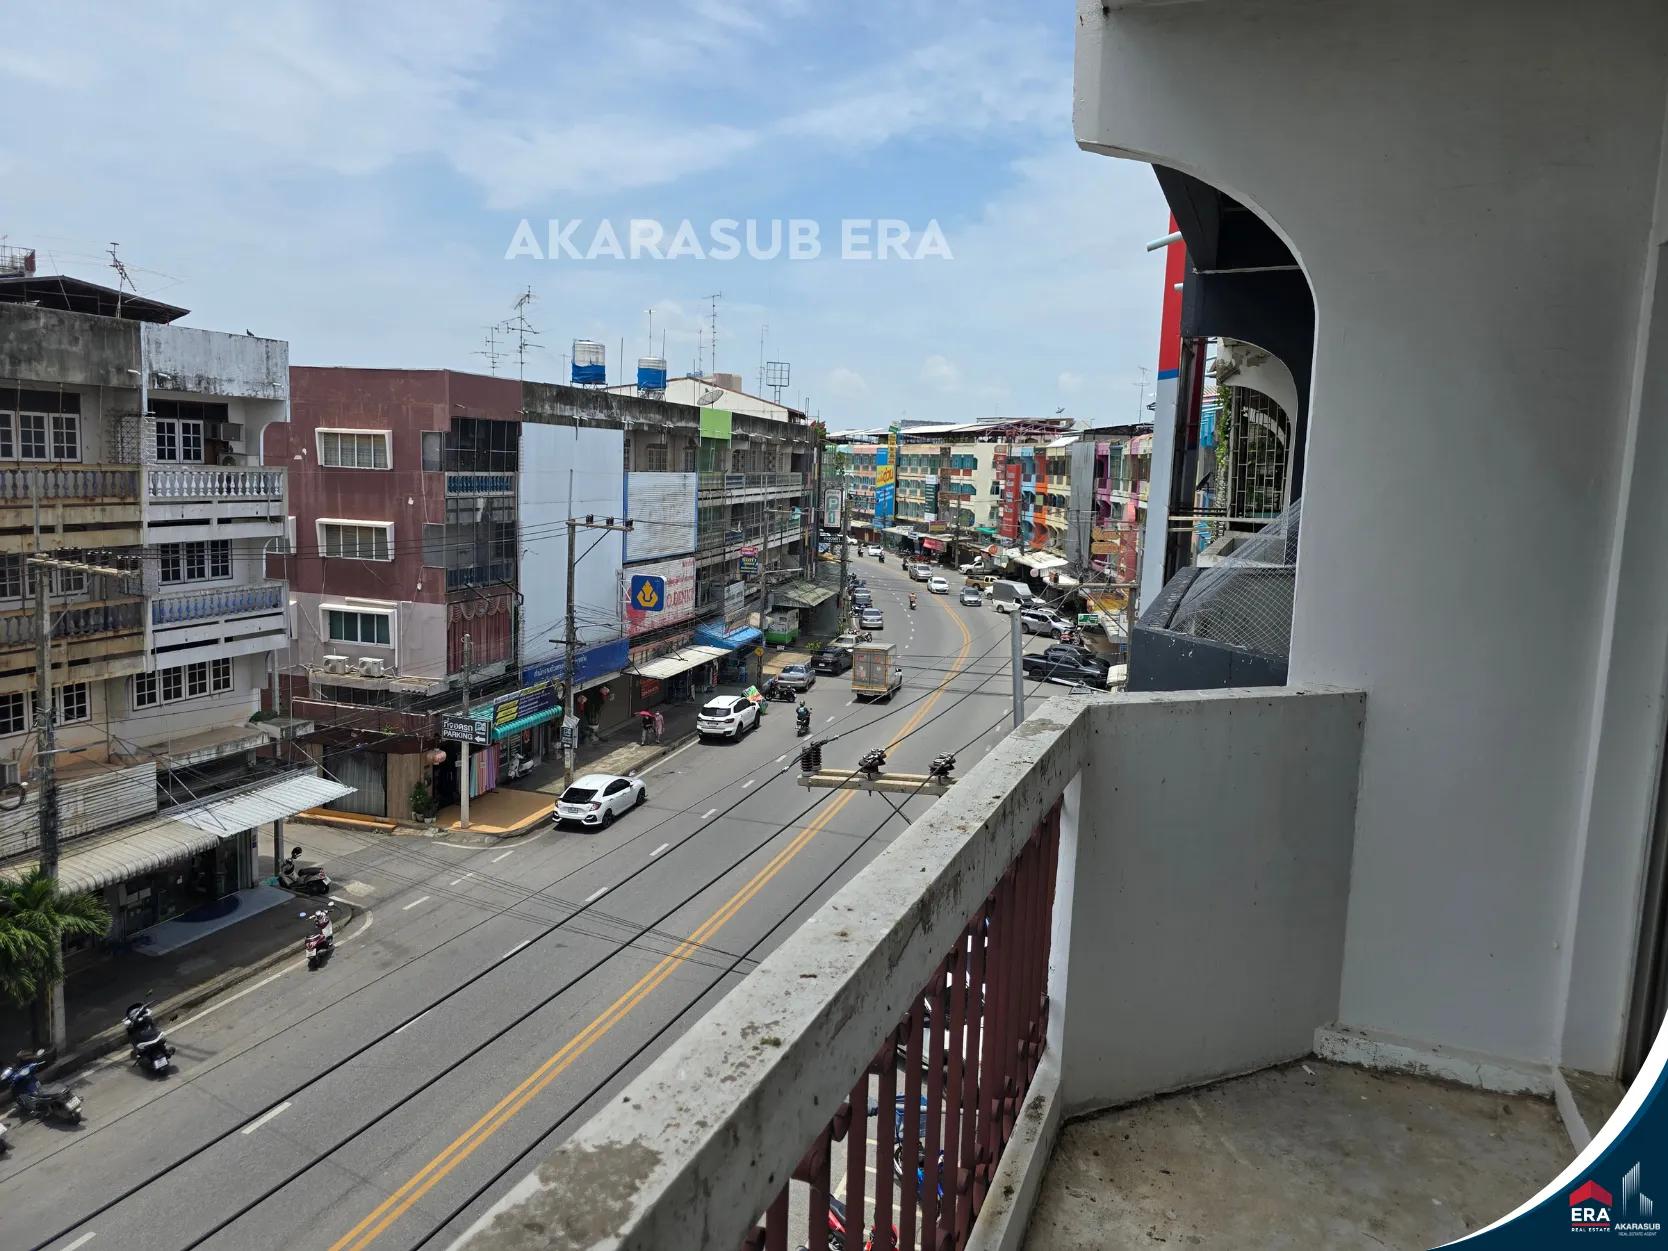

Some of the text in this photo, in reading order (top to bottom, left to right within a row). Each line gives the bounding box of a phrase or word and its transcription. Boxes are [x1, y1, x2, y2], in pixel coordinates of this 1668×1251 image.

[443, 718, 473, 732] ที่จอดรถ
[443, 730, 473, 741] PARKING
